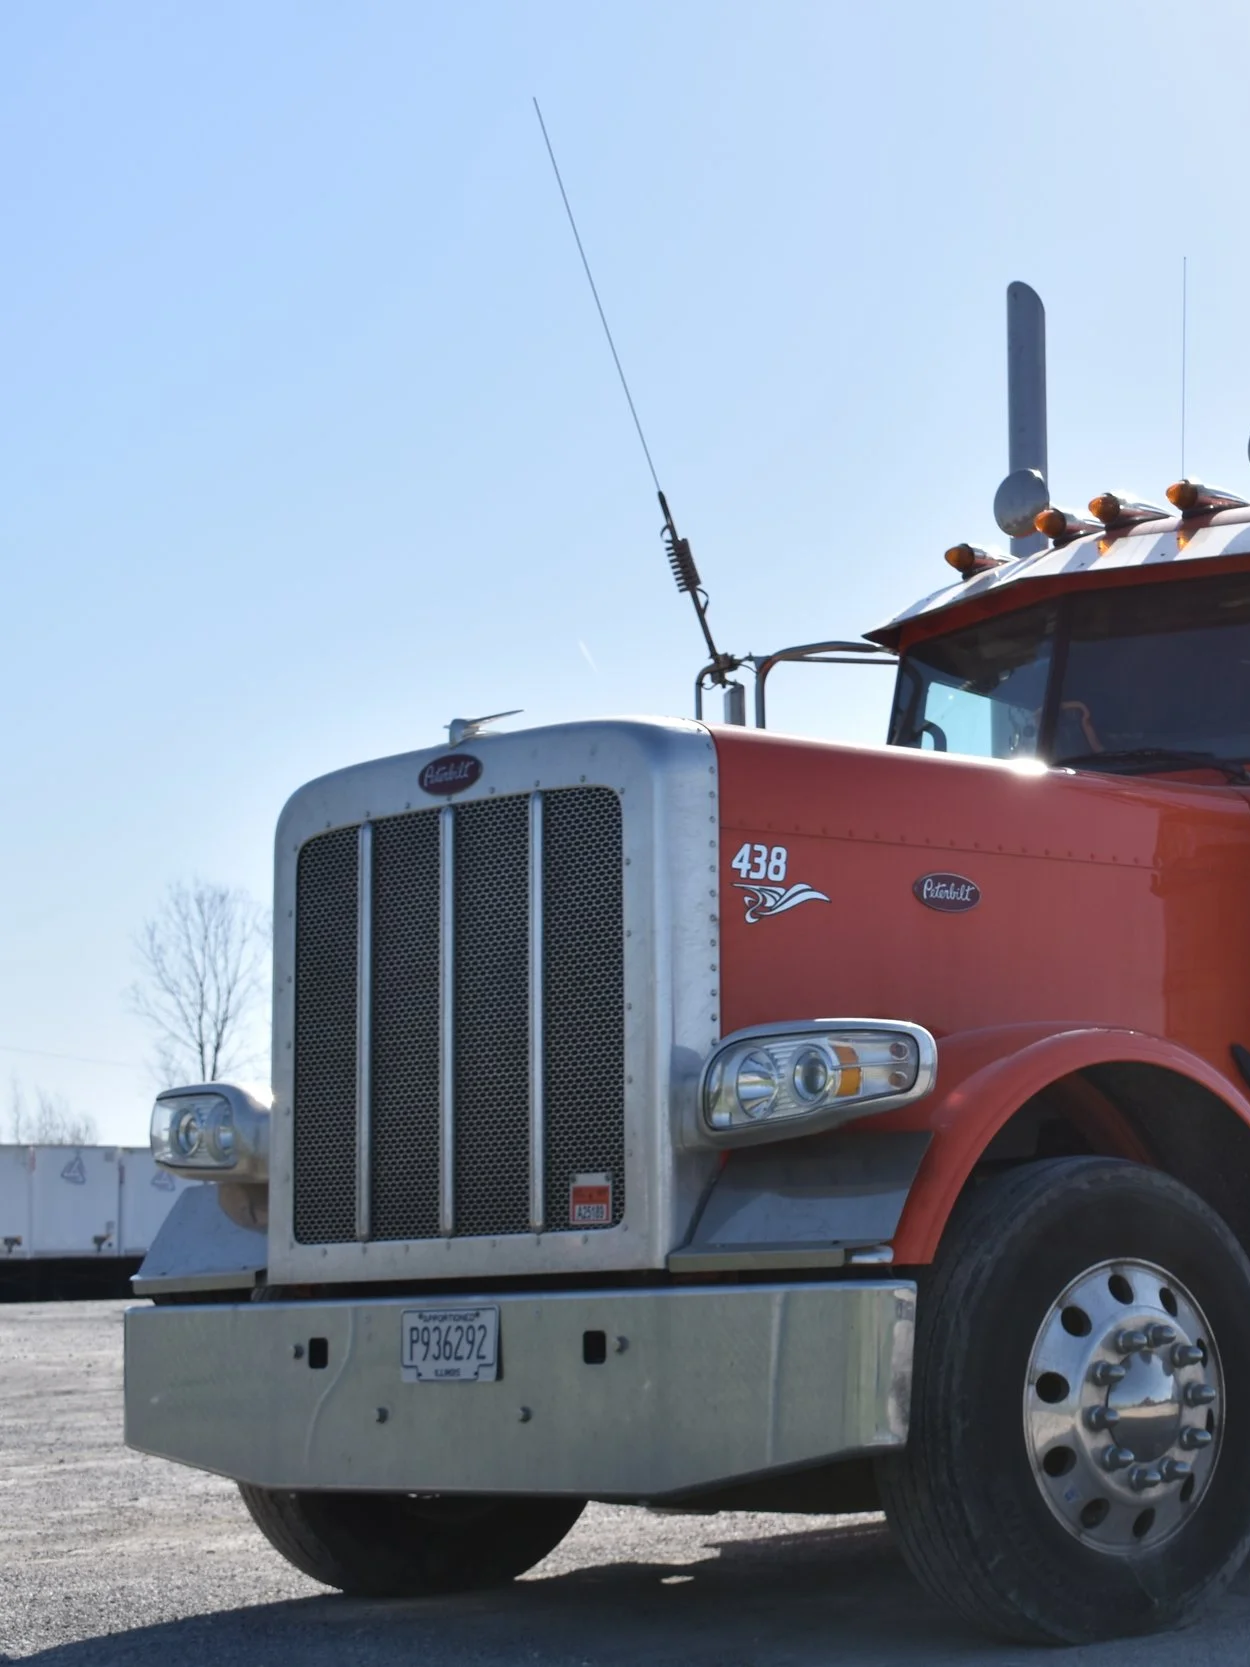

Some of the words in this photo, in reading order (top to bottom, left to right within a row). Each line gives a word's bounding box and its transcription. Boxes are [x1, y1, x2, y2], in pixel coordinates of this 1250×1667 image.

[732, 843, 787, 882] 438
[923, 878, 975, 901] Peterbilt
[410, 1324, 487, 1361] P936292
